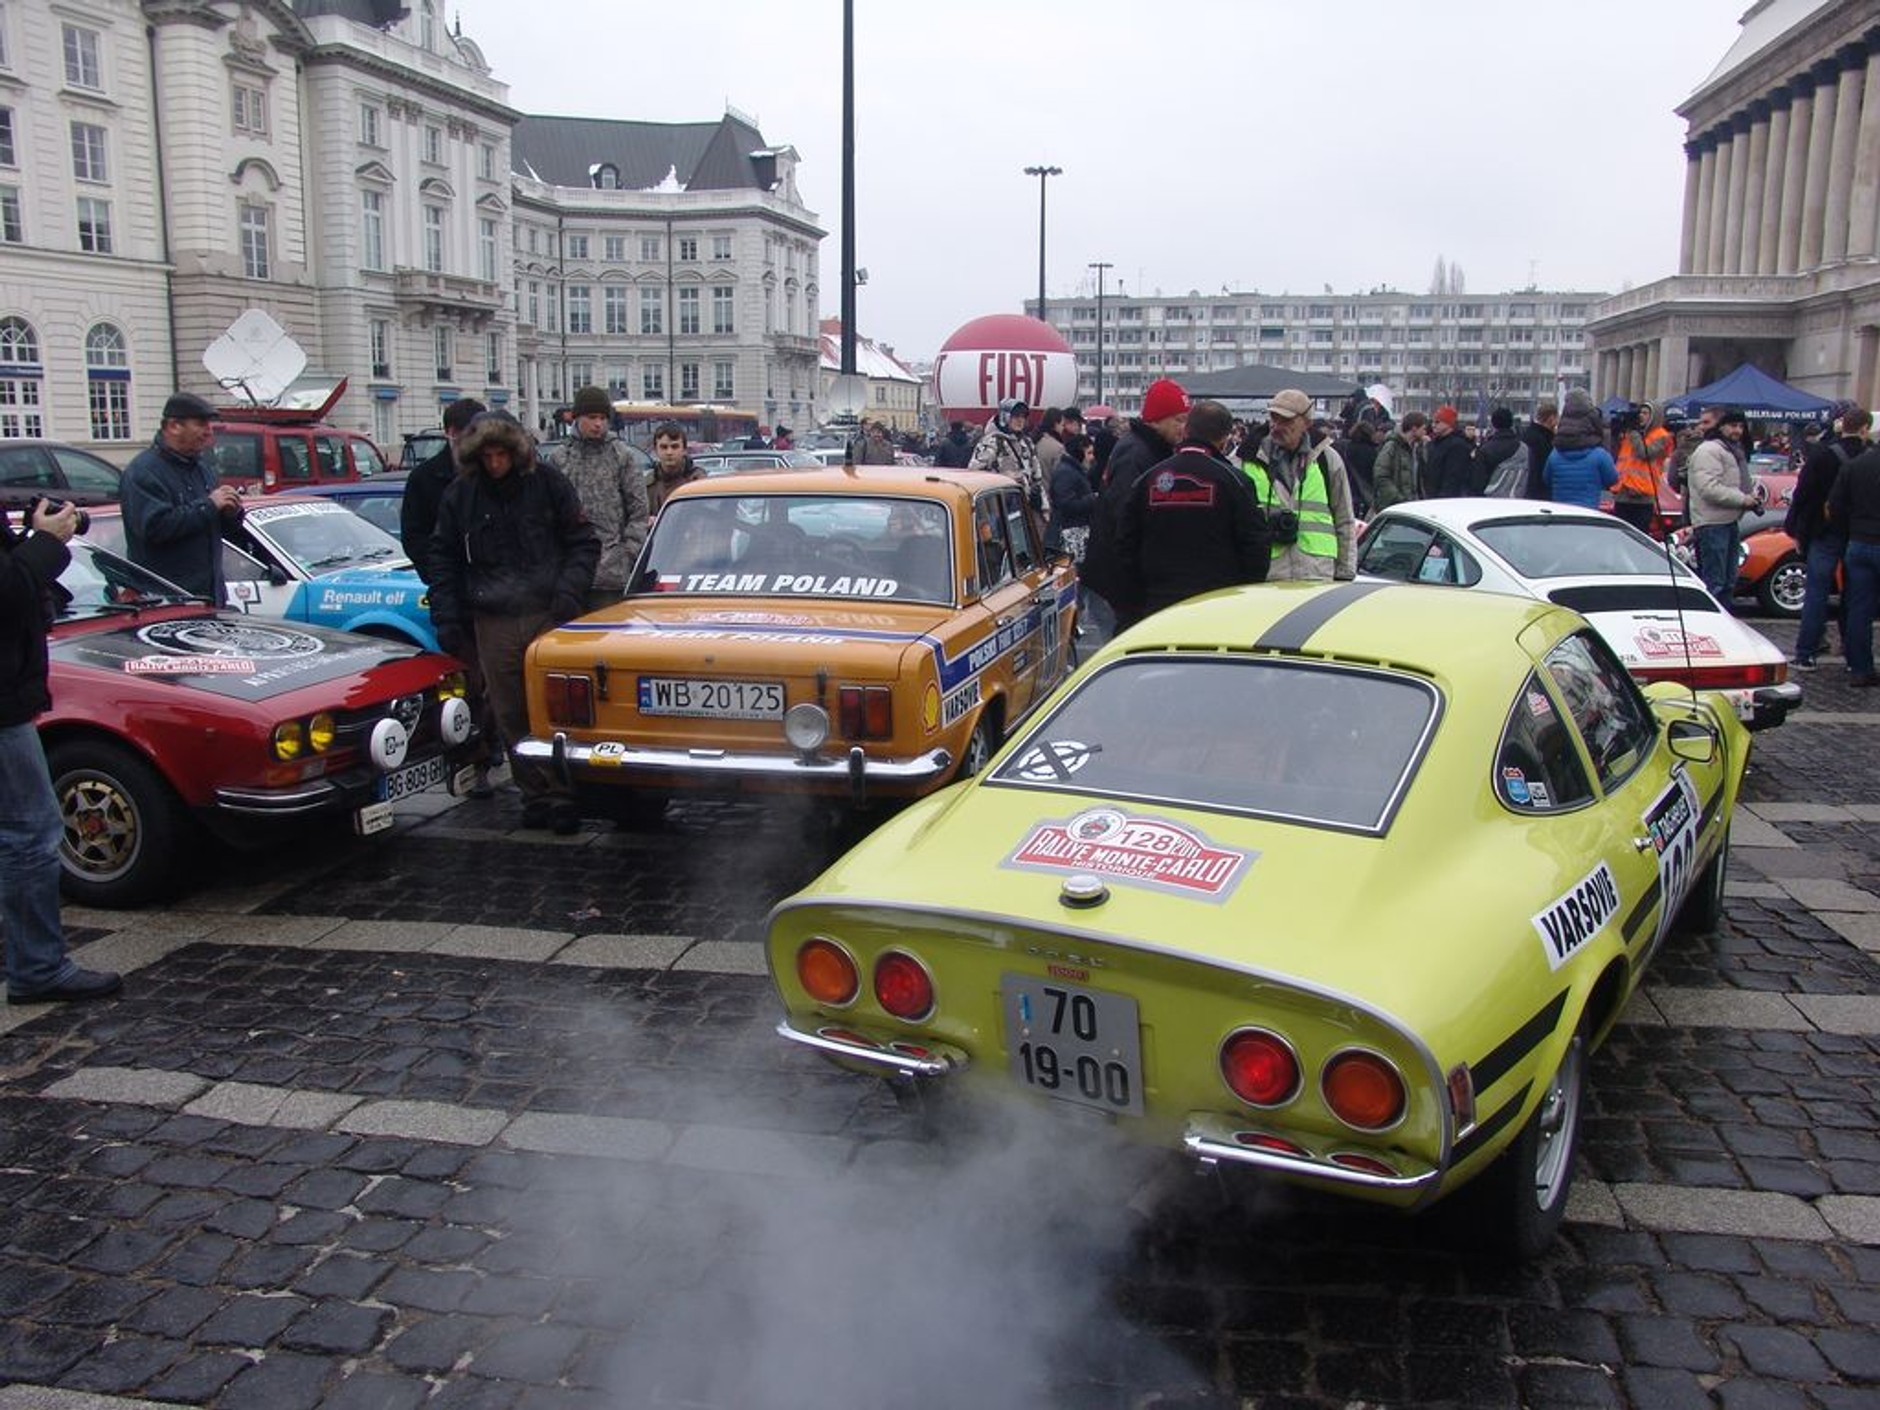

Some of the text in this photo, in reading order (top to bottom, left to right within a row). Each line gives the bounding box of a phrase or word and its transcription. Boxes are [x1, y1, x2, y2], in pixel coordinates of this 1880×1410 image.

[979, 352, 1047, 406] FIAT
[323, 590, 406, 605] Renault elf
[685, 574, 898, 596] TEAM POLAND
[655, 682, 780, 710] WB 20125
[598, 744, 618, 754] PL
[1120, 829, 1173, 852] 128
[1028, 829, 1235, 883] RALLYE MONTE-CARLO
[1071, 859, 1158, 880] HISTORIQUE
[1540, 866, 1617, 958] VARSOVIE
[1043, 987, 1097, 1042] 70
[1019, 1042, 1130, 1107] 19-00
